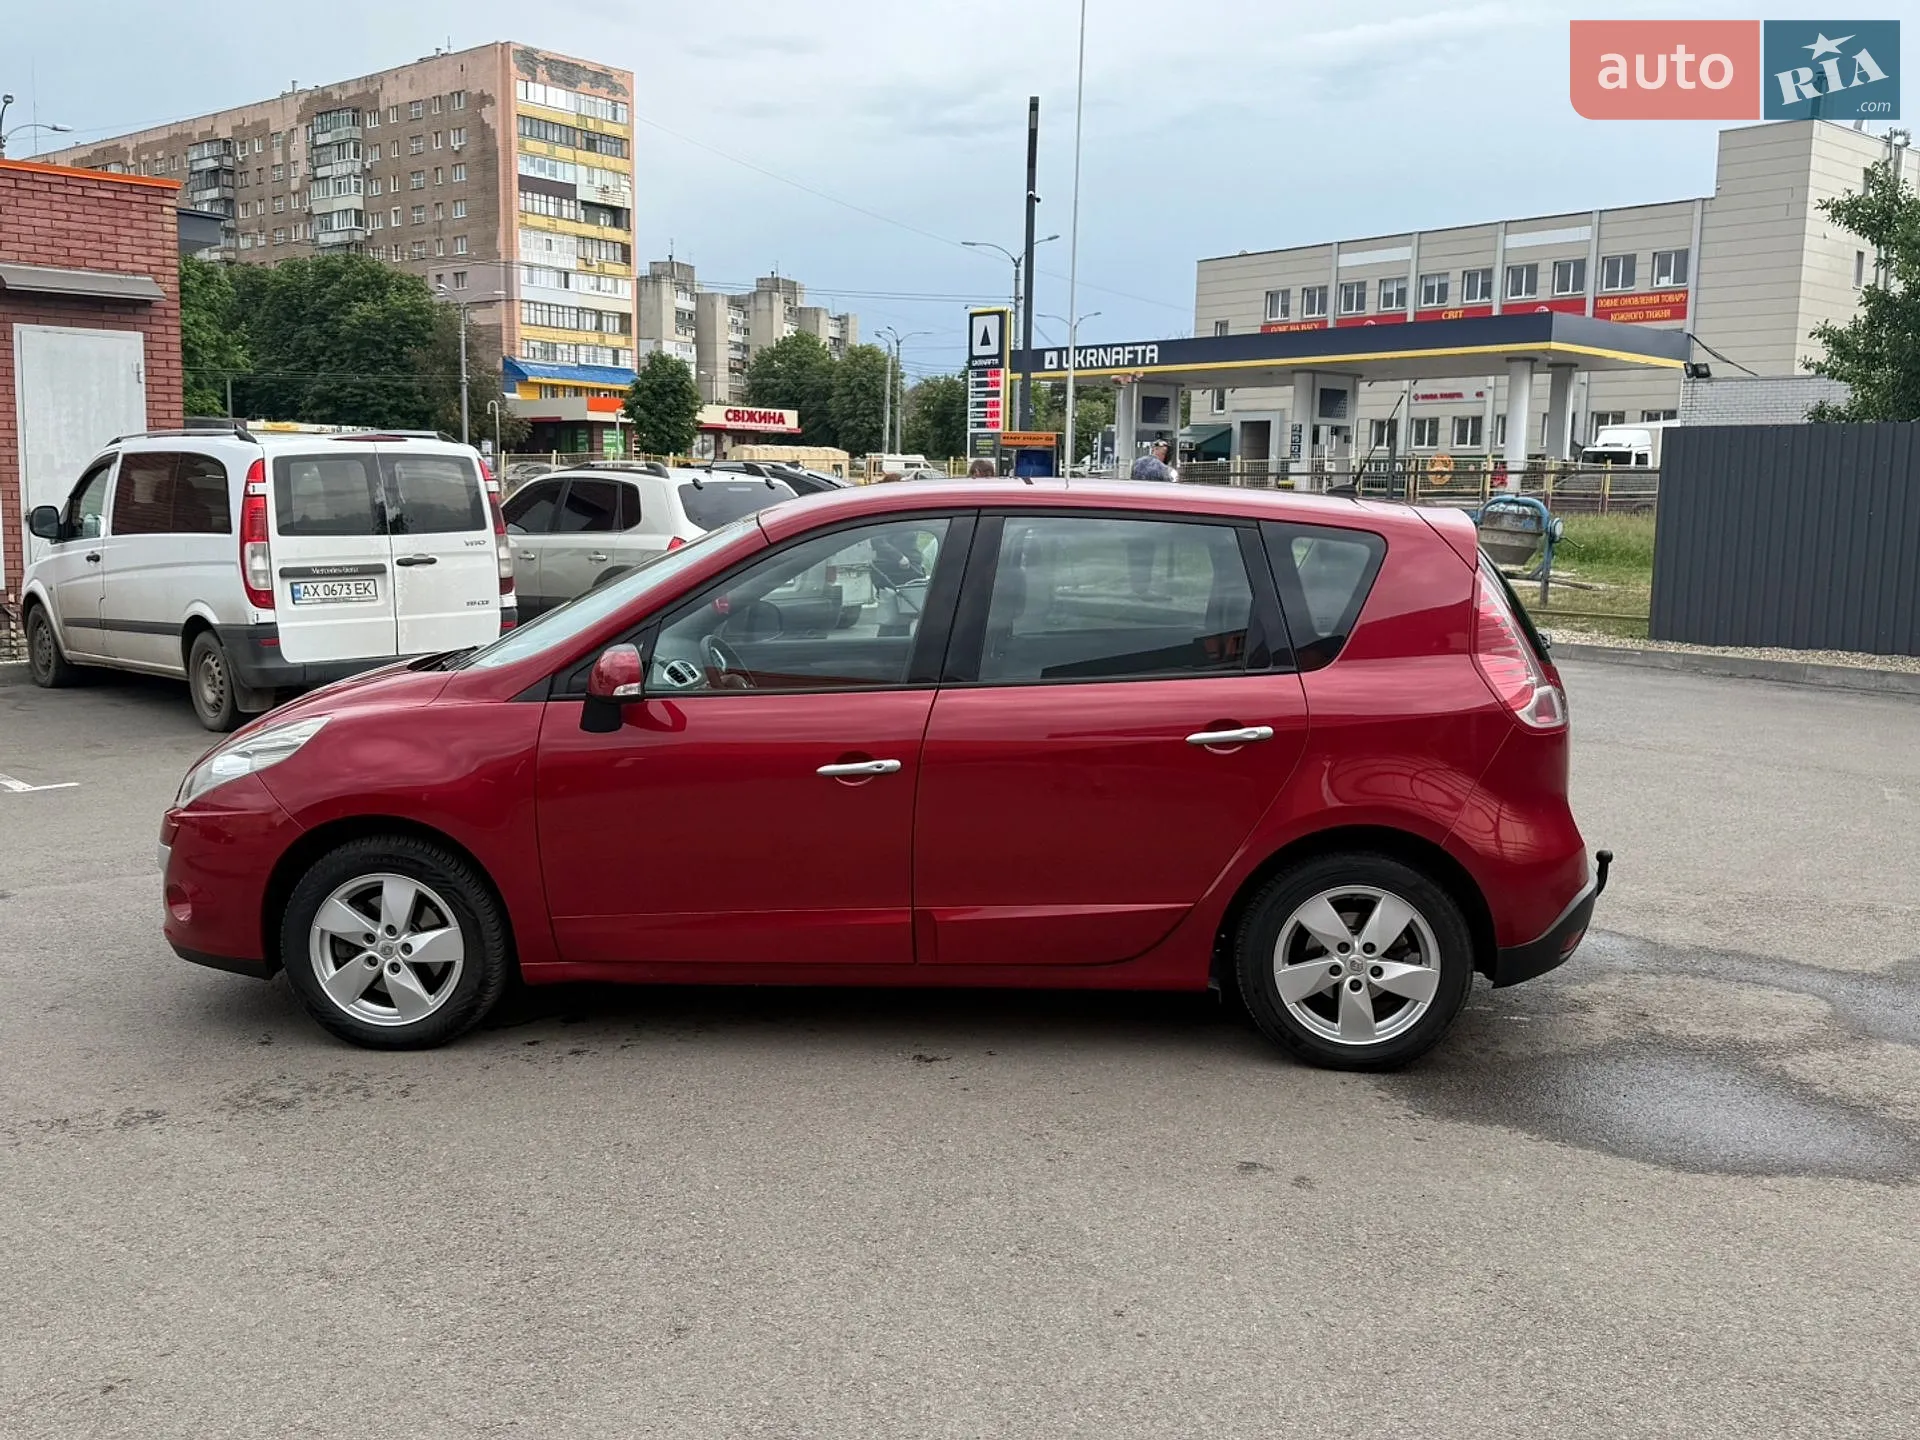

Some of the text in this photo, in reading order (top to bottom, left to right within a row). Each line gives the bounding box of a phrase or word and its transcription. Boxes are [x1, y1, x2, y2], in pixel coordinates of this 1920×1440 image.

[1620, 294, 1660, 306] ОНОВЛЕННЯ
[1661, 292, 1687, 303] ТОВАРУ
[1062, 344, 1158, 369] UKRNAFTA
[725, 408, 786, 425] СВІЖИНА
[302, 584, 320, 597] AX
[323, 583, 352, 596] 0673
[354, 582, 373, 595] EK
